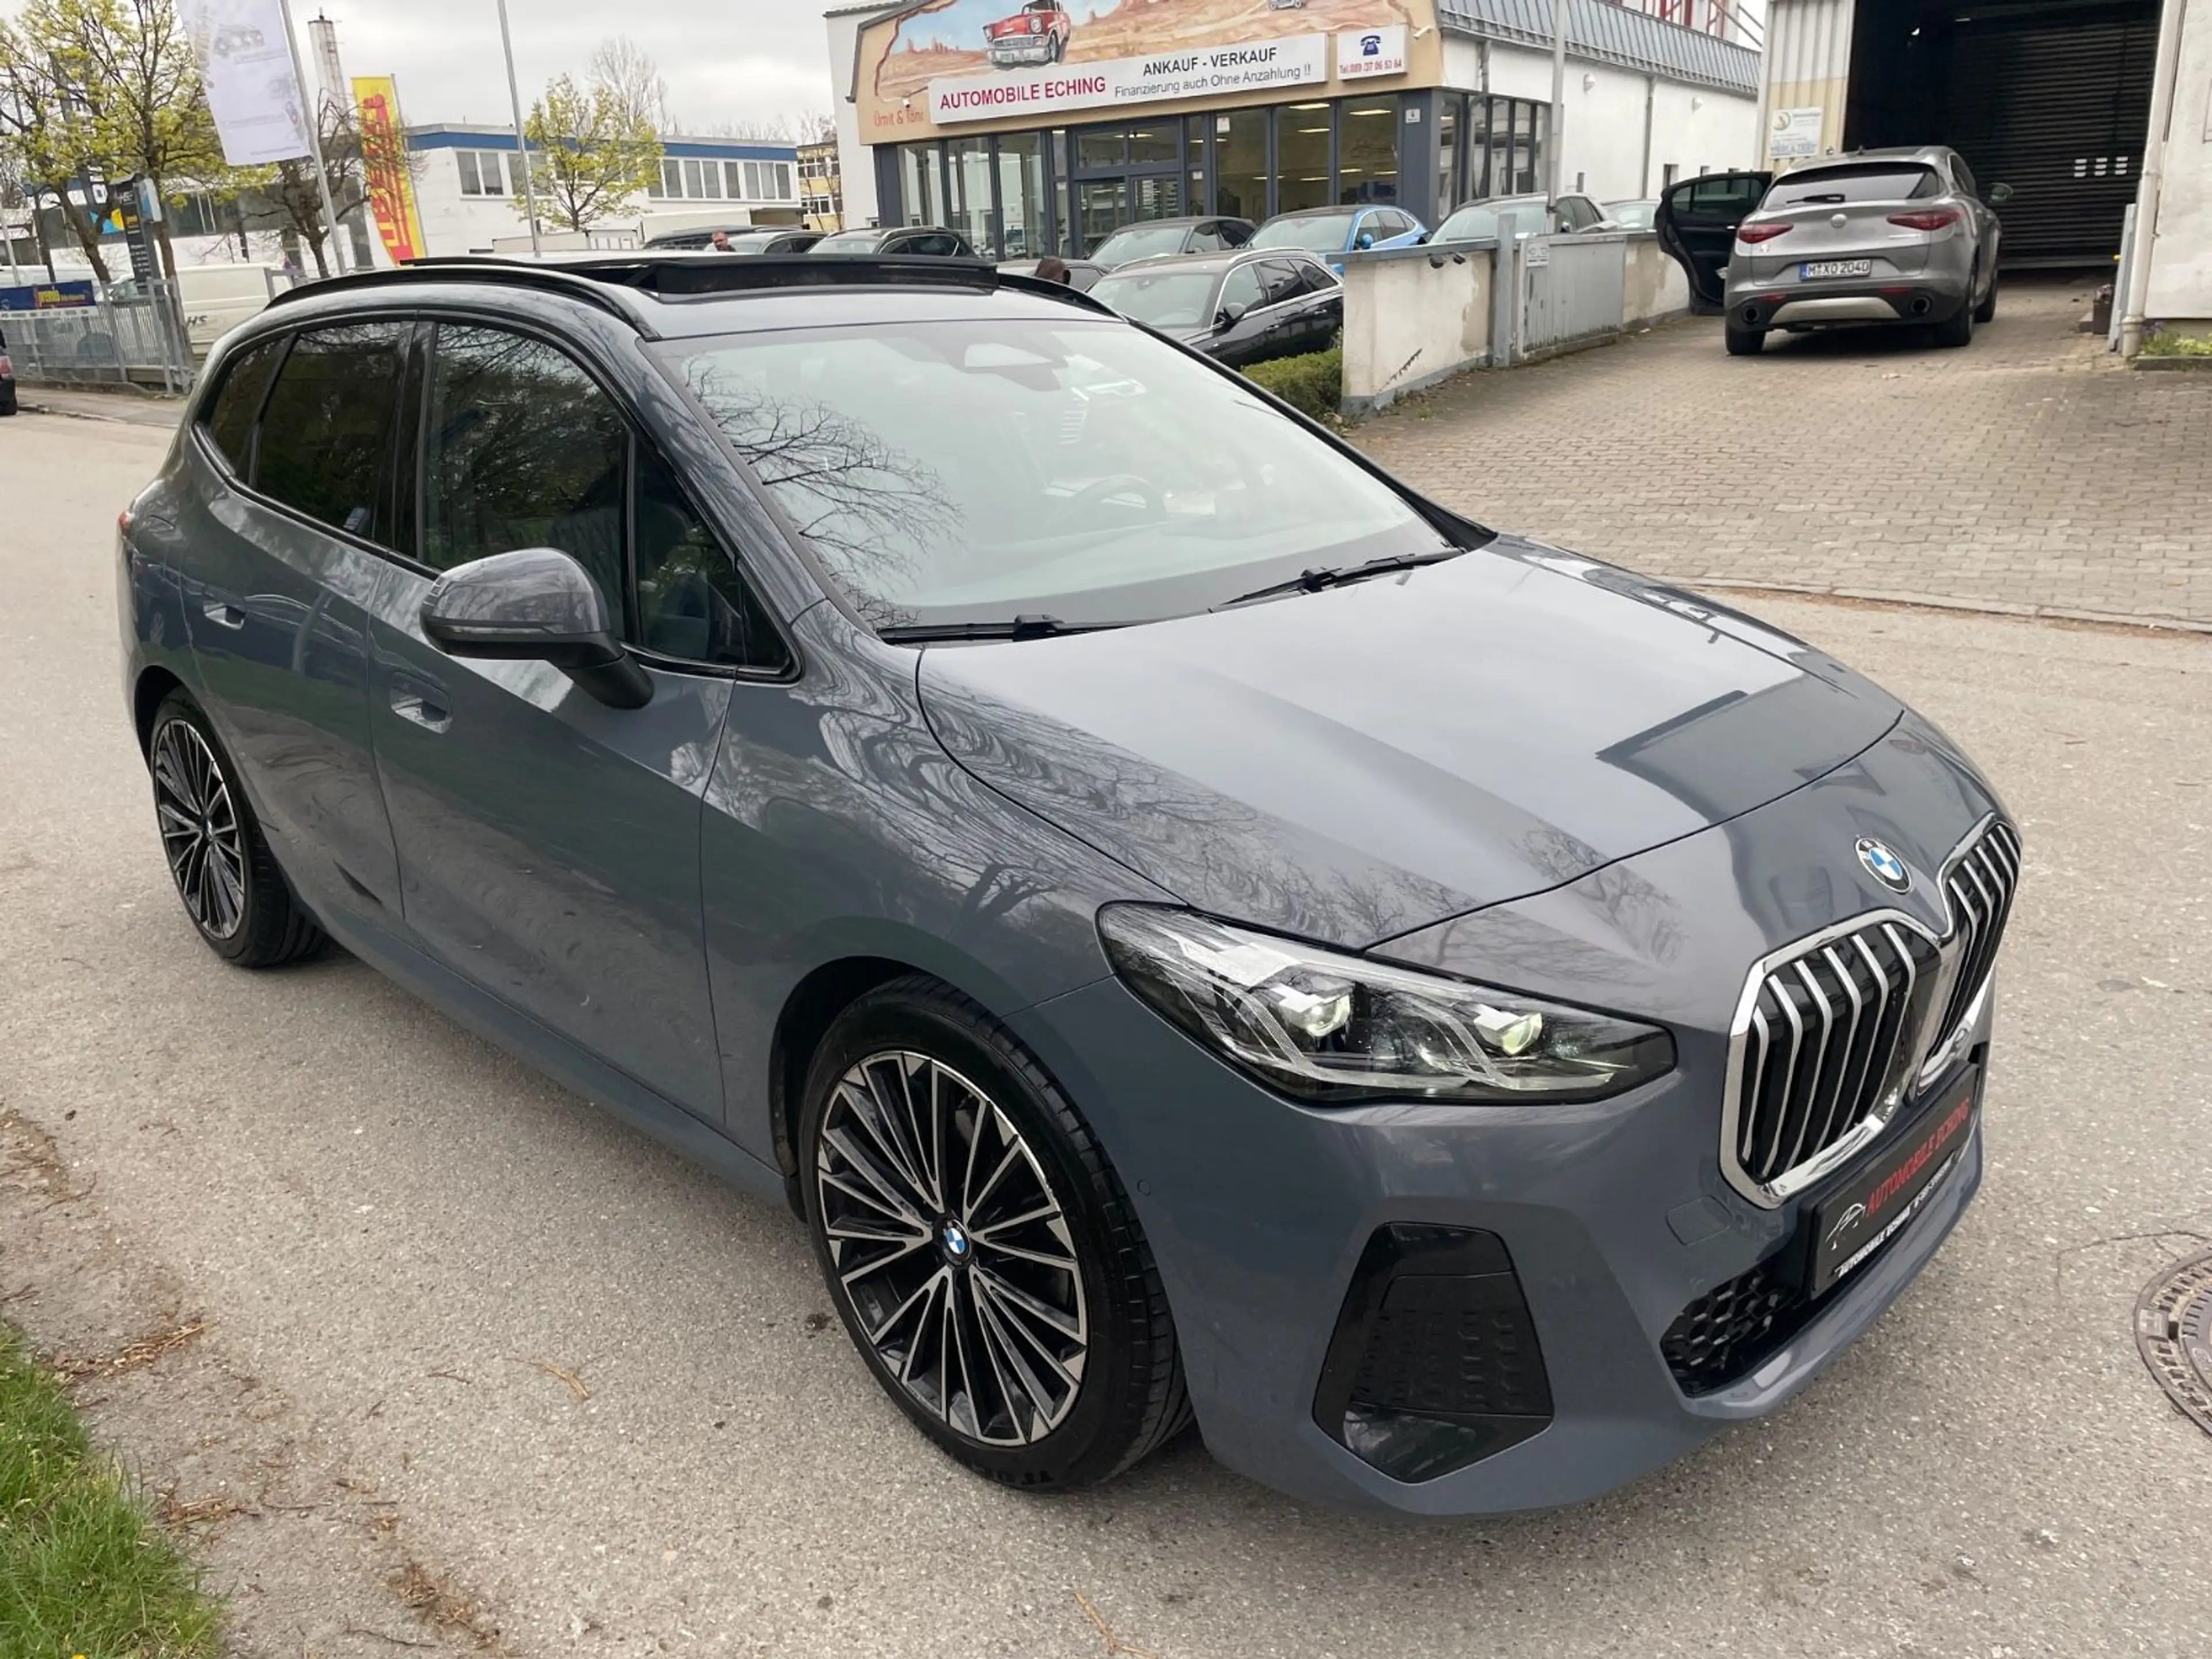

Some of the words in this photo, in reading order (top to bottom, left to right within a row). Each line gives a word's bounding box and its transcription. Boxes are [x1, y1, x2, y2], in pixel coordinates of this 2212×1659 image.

[1143, 57, 1198, 76] ANKAUF
[1210, 47, 1277, 67] VERKAUF
[940, 84, 1040, 109] AUTOMOBILE
[1045, 76, 1105, 98] ECHING
[1115, 81, 1180, 97] Finanzierung
[1183, 77, 1207, 89] auch
[1211, 74, 1240, 86] Ohne
[1243, 67, 1300, 84] Anzahlung
[897, 110, 903, 124] &
